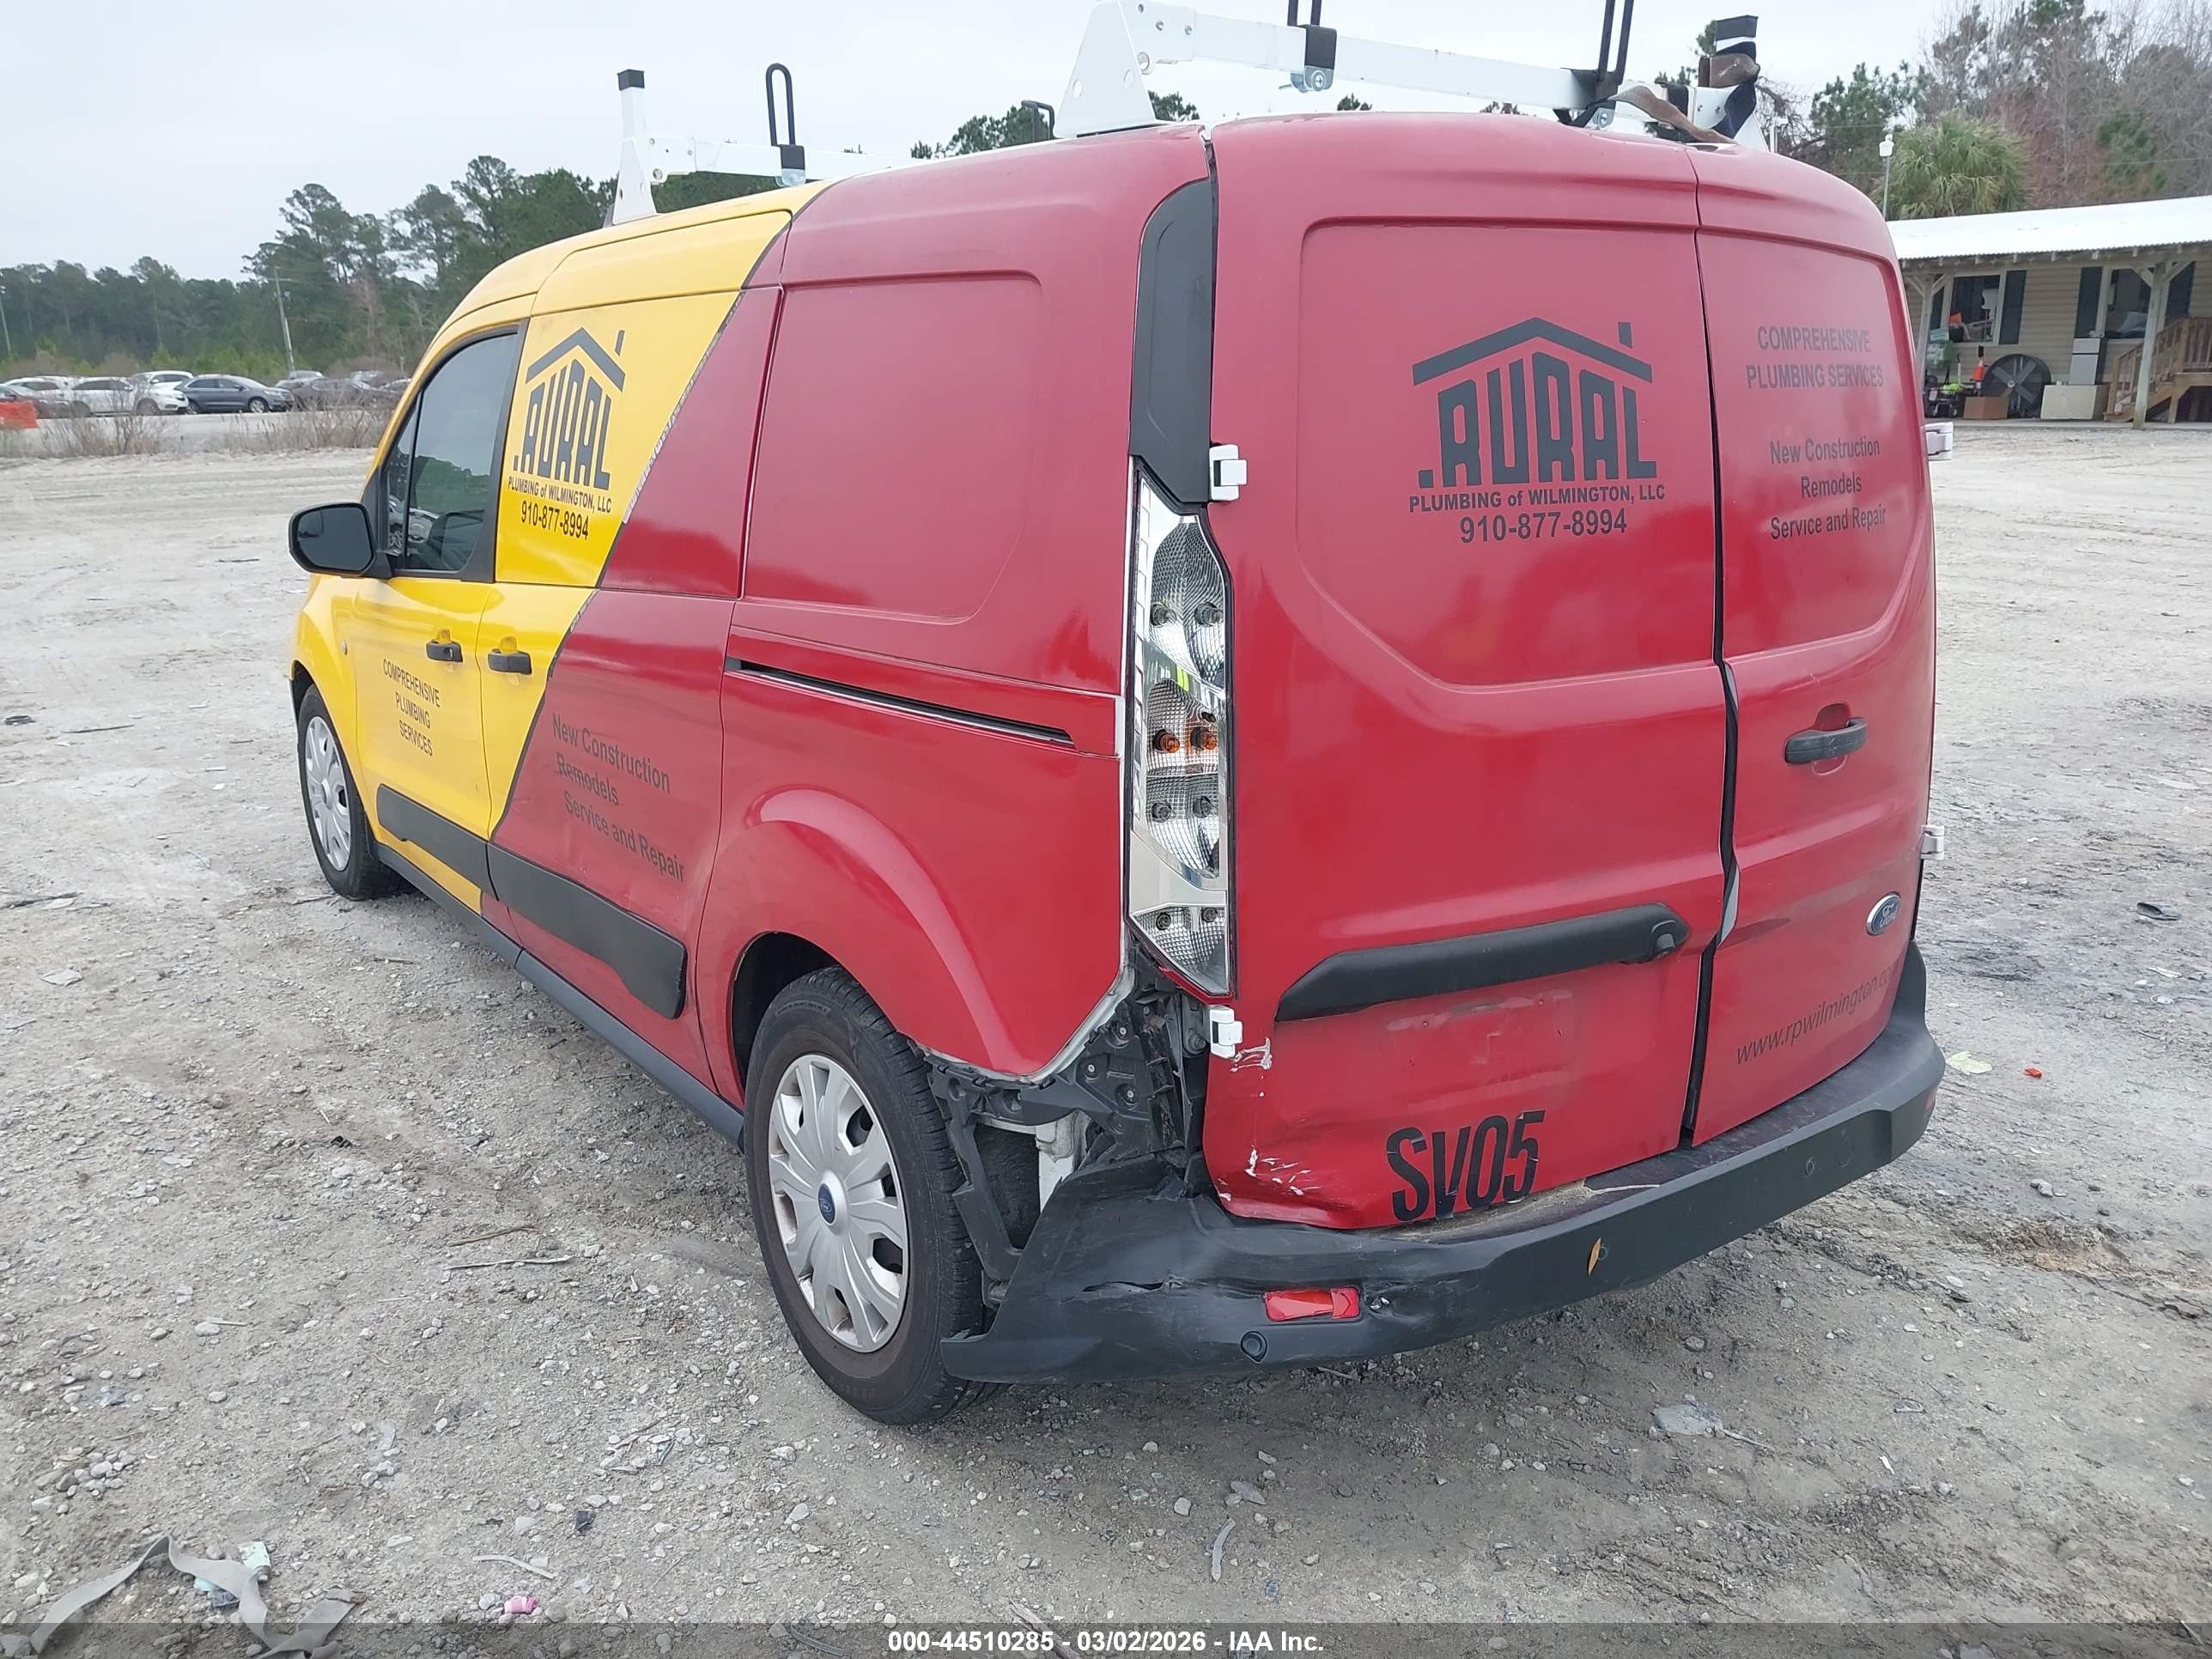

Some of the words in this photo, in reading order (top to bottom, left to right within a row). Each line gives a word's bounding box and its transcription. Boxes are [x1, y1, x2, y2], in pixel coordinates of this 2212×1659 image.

[1757, 325, 1872, 353] COMPREHENSIVE
[1746, 363, 1826, 389] PLUMBING
[1828, 363, 1884, 388] SERVICES
[520, 358, 612, 491] RURAL
[1437, 350, 1657, 488] RURAL
[1770, 440, 1801, 465] New
[1805, 437, 1881, 462] Construction
[507, 475, 539, 496] PLUMBING
[539, 483, 548, 499] of
[548, 485, 596, 514] WILMINGTON,
[597, 497, 612, 514] LLC
[1409, 491, 1502, 514] PLUMBING
[1507, 489, 1523, 507] of
[1528, 485, 1636, 506] WILMINGTON,
[1639, 483, 1666, 501] LLC
[1800, 472, 1863, 499] Remodels
[520, 499, 589, 541] 910-877-8994
[1459, 507, 1628, 544] 910-877-8994
[1771, 515, 1822, 540] Service
[1826, 508, 1849, 532] and
[1852, 503, 1887, 532] Repair
[382, 658, 441, 708] COMPREHENSIVE
[395, 691, 431, 729] PLUMBING
[398, 719, 434, 757] SERVICES
[552, 713, 579, 748] New
[580, 727, 672, 794] Construction
[556, 751, 620, 806] Remodels
[562, 789, 609, 835] Service
[611, 820, 637, 854] and
[639, 834, 686, 883] Repair
[1385, 1109, 1546, 1222] SV05
